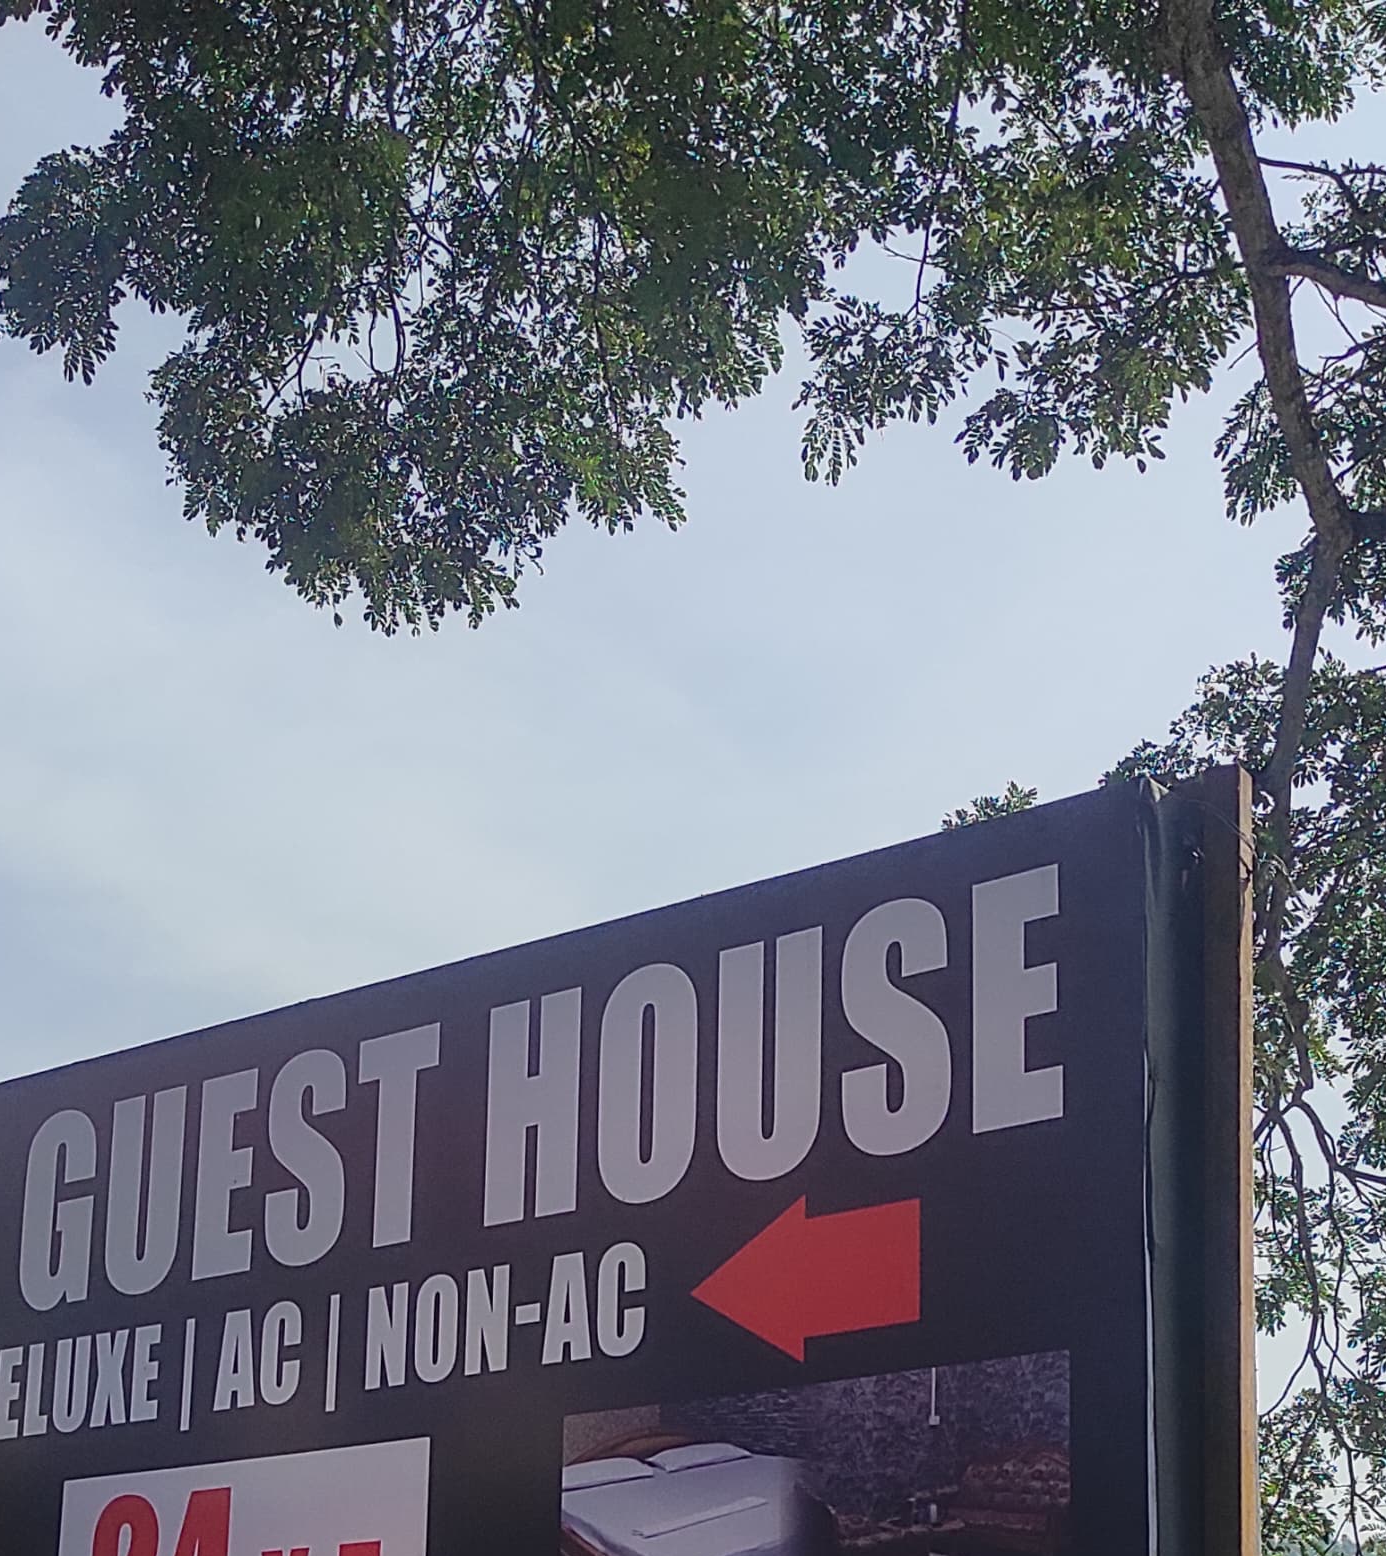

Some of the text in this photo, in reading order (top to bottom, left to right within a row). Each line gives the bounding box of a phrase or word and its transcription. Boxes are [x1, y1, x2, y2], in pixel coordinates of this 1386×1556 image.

[18, 1022, 441, 1311] GUEST
[483, 863, 1064, 1227] HOUSE
[213, 1300, 303, 1412] AC
[363, 1242, 647, 1391] NON-AC
